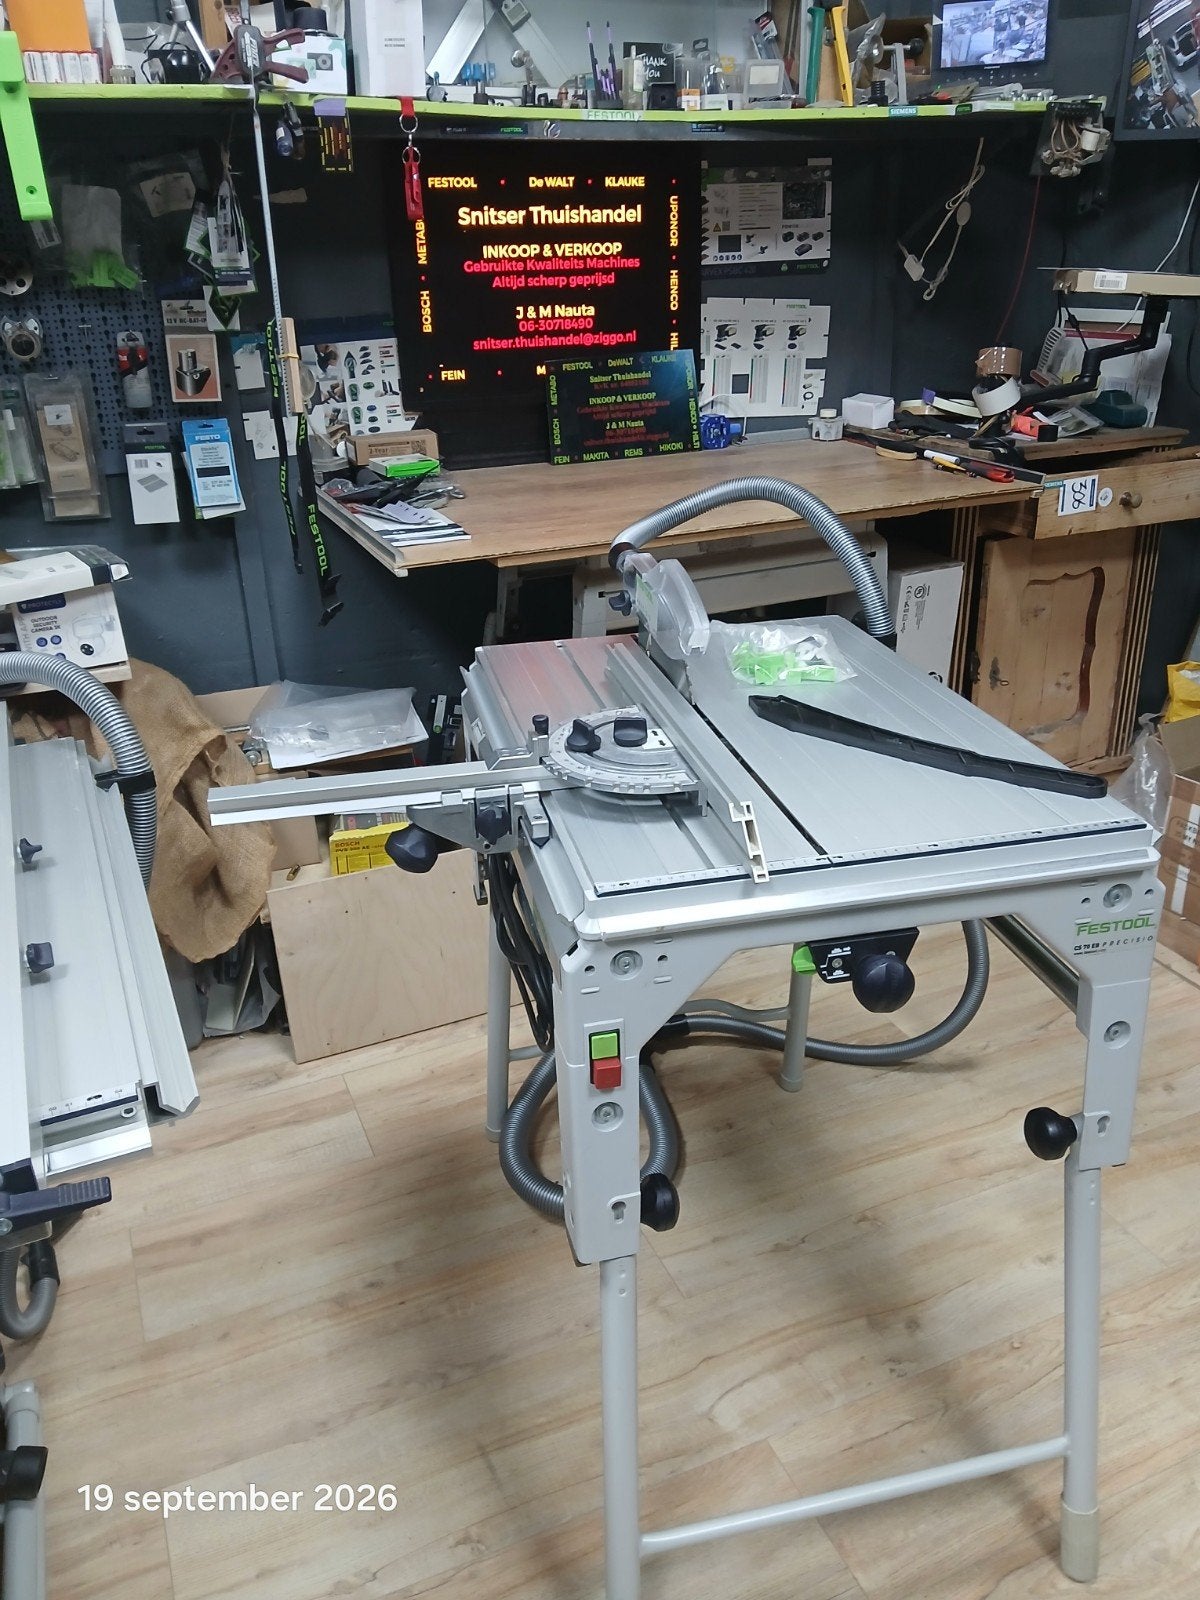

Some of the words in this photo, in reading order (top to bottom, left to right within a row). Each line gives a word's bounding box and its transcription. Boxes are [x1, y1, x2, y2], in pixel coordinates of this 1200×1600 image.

[638, 53, 668, 66] THANK
[428, 176, 478, 188] FESTOOL
[605, 176, 646, 187] KLAUKE
[458, 206, 526, 226] Snitser
[529, 204, 642, 225] Thuishandel
[670, 196, 679, 247] UPONOR
[483, 244, 540, 258] INKOOP
[542, 244, 552, 256] &
[555, 242, 622, 256] VERKOOP
[464, 259, 524, 272] Gebruikte
[526, 258, 584, 271] Kwaliteits
[586, 256, 640, 269] Machines
[492, 274, 526, 288] Altijd
[528, 274, 568, 288] scherp
[570, 272, 614, 287] geprijsd
[670, 270, 679, 311] HENCO
[420, 290, 432, 333] BOSCH
[516, 306, 524, 320] J
[526, 306, 536, 318] &
[539, 306, 552, 318] M
[554, 304, 595, 317] Nauta
[519, 318, 594, 332] 06-30718490
[473, 332, 637, 350] snitser.thuishandel@ziggo.nl
[562, 362, 593, 371] FESTOOL
[441, 370, 466, 381] FEIN
[549, 375, 557, 406] METABO
[590, 396, 616, 405] INKOOP
[624, 392, 656, 402] VERKOOP
[554, 455, 570, 464] FEIN
[583, 451, 610, 461] MAKITA
[624, 448, 643, 457] REMS
[659, 443, 684, 452] HIKOKI
[1072, 480, 1088, 510] 306
[307, 504, 330, 577] FESTOOL
[1076, 916, 1154, 936] FESTOOL
[1102, 936, 1154, 947] PRECISIO
